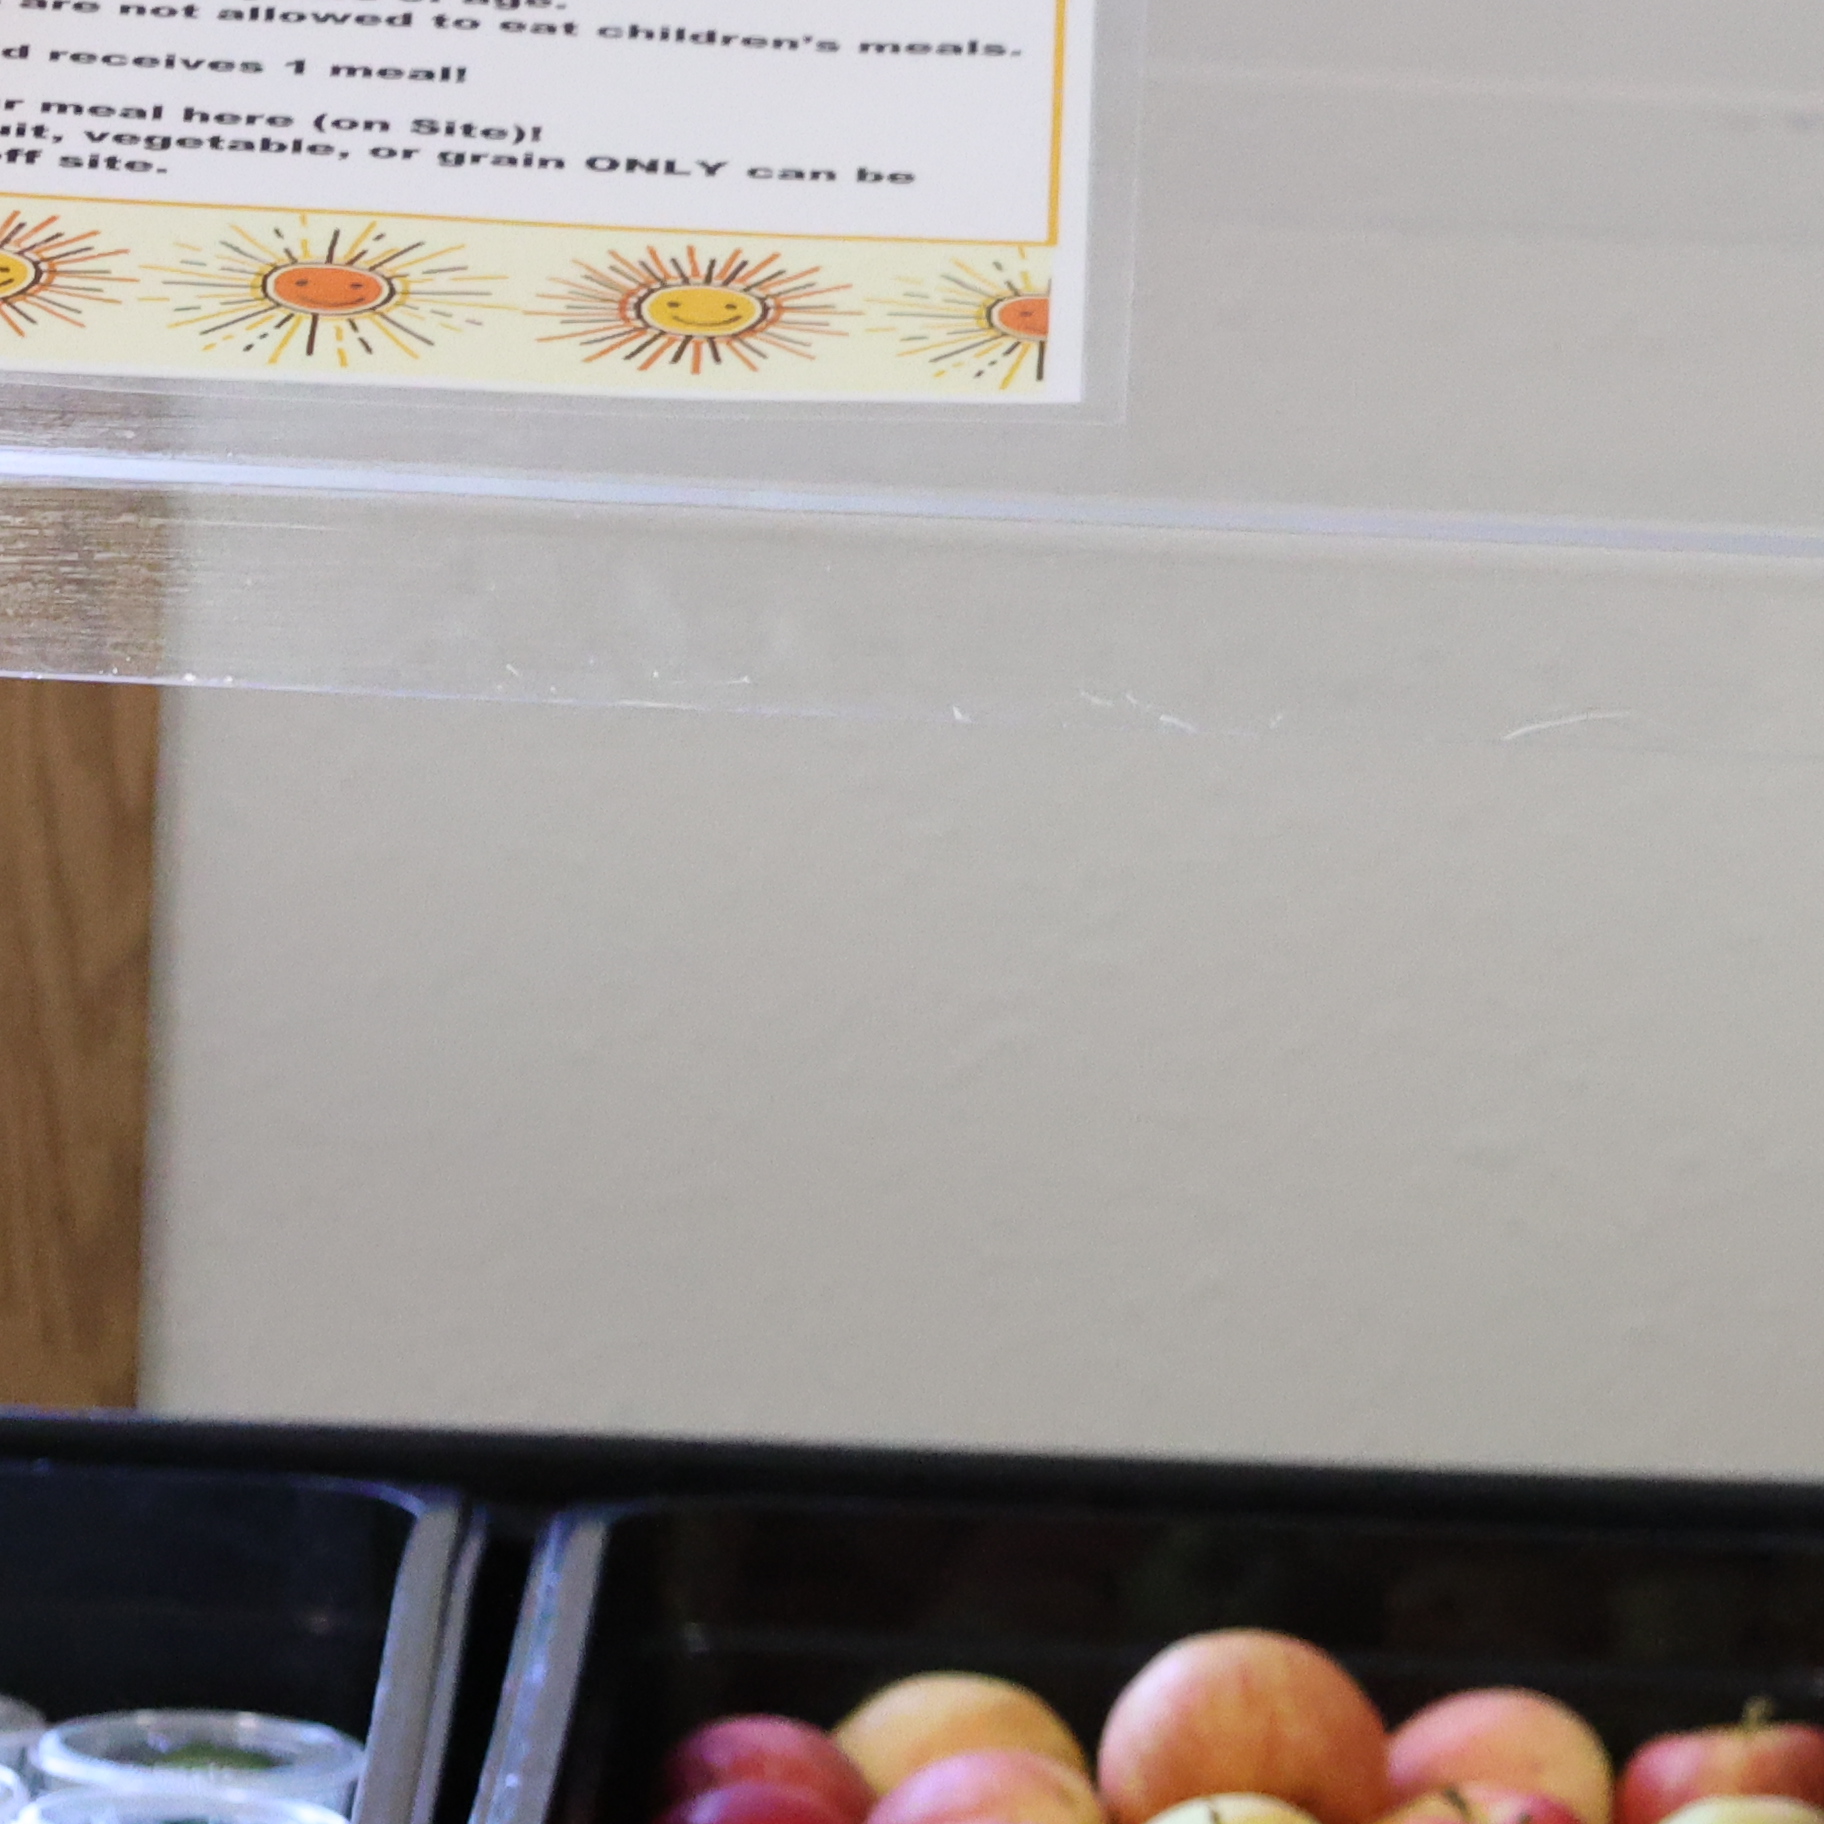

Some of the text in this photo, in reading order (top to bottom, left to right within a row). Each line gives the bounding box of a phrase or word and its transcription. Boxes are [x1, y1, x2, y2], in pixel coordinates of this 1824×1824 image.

[20, 0, 1022, 57] are not allowed to eat children's meals.
[1, 44, 467, 83] d receives 1 meal!
[41, 101, 164, 121] meal
[183, 106, 294, 128] here
[313, 113, 391, 133] (on
[411, 118, 543, 146] Site)!
[0, 149, 168, 174] ff site.
[84, 130, 349, 160] vegetable,
[369, 147, 420, 160] or
[437, 151, 566, 170] grain
[585, 156, 729, 177] ONLY
[747, 167, 837, 182] can
[856, 167, 916, 184] be
